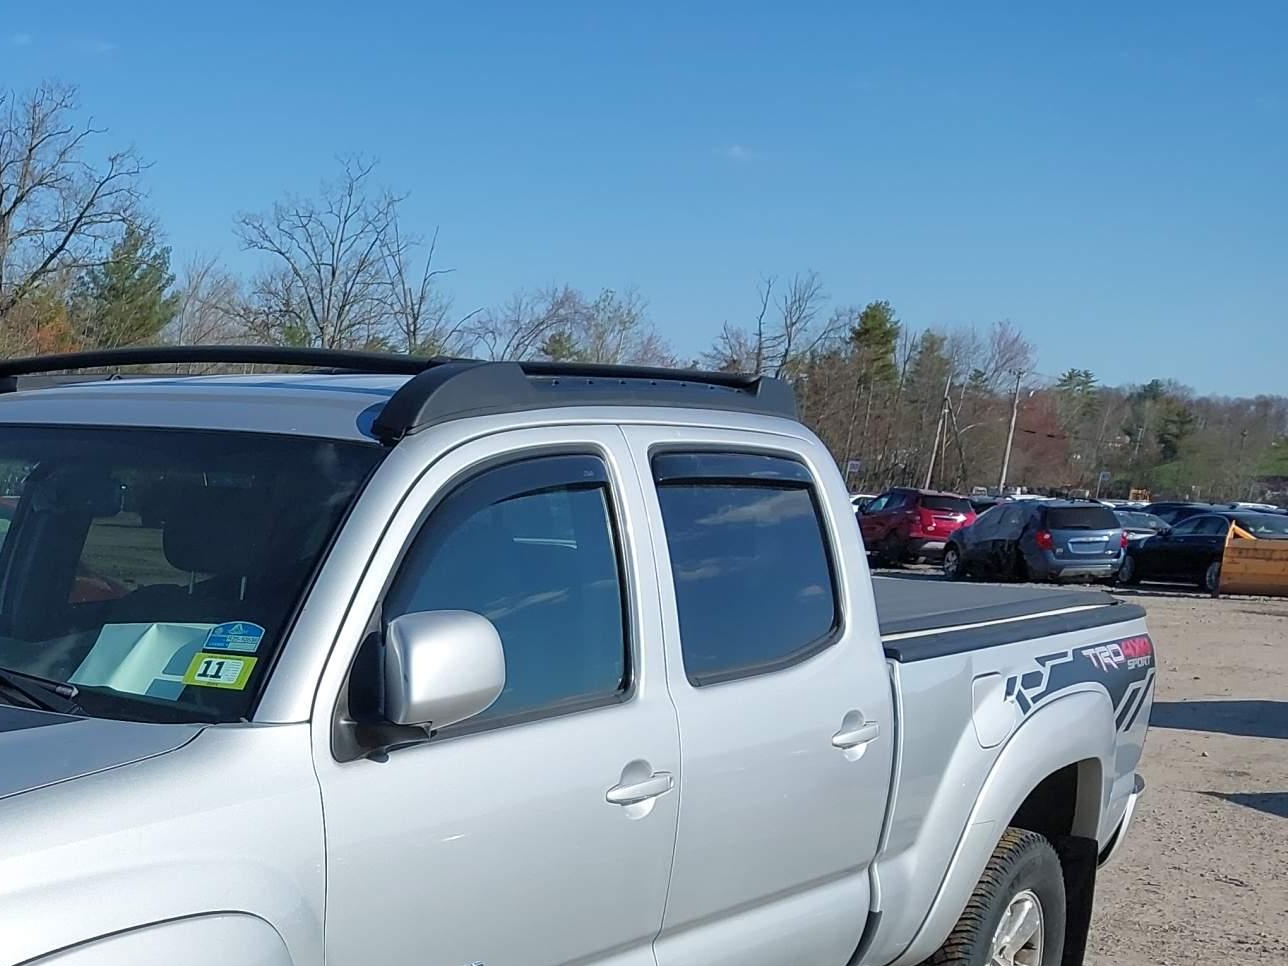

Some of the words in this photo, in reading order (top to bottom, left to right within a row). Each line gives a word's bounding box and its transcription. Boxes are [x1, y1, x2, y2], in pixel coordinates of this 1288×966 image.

[1081, 643, 1126, 673] TRD
[1127, 655, 1152, 670] SPORT
[197, 660, 225, 679] 11
